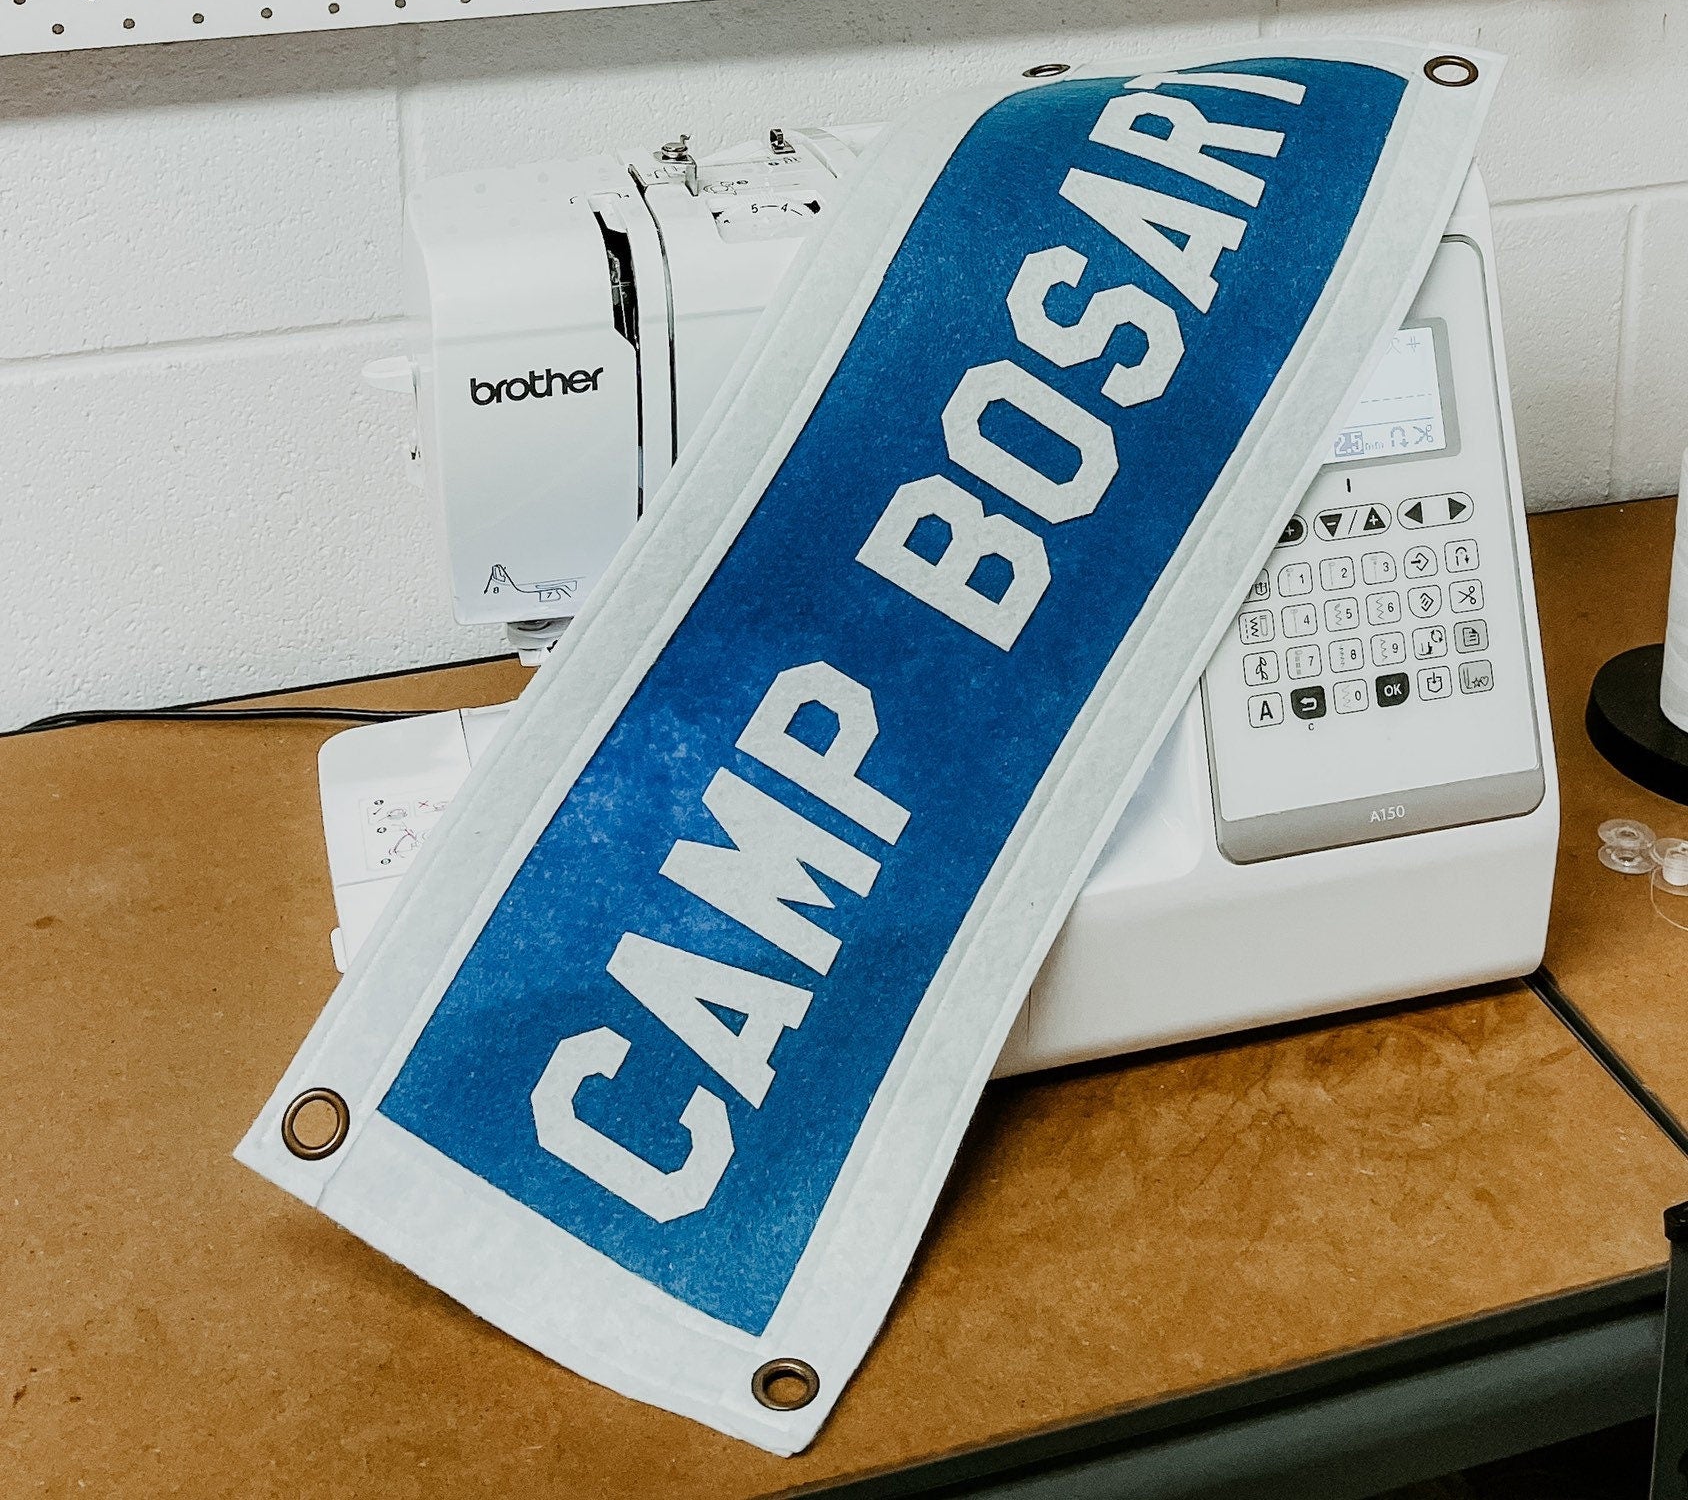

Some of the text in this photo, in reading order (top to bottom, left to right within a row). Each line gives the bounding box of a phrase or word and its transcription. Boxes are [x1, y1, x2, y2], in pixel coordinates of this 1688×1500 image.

[751, 203, 788, 214] 5 4
[470, 367, 604, 406] brother
[1382, 562, 1389, 572] 3
[1299, 574, 1305, 584] 1
[1341, 568, 1348, 579] 2
[1387, 602, 1394, 613] 6
[1346, 608, 1353, 619] 5
[1303, 614, 1310, 625] 4
[1392, 643, 1399, 654] 9
[1350, 649, 1357, 660] 8
[1308, 656, 1315, 667] 7
[1384, 682, 1402, 697] OK
[1354, 690, 1362, 701] 0
[1259, 700, 1274, 721] A
[1369, 805, 1406, 823] A150
[530, 660, 912, 1224] CAMP
